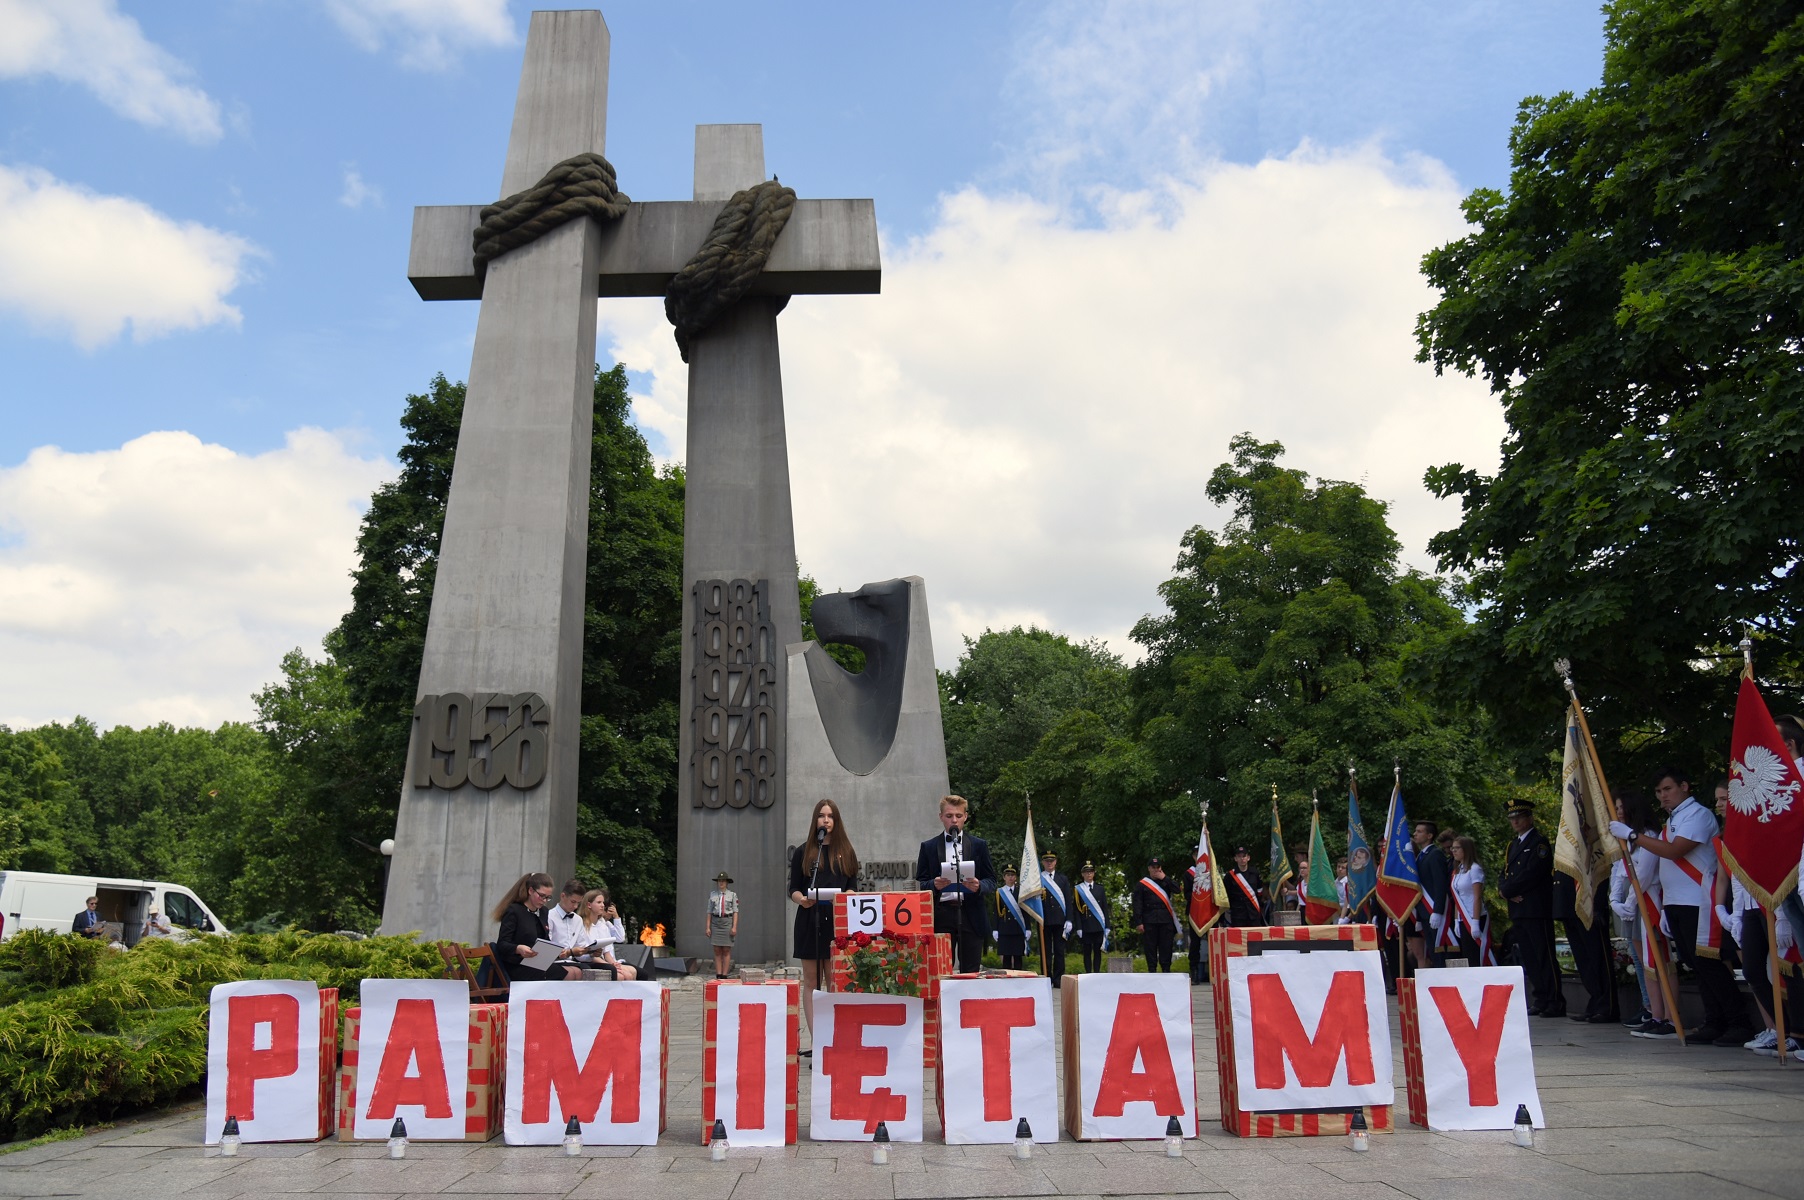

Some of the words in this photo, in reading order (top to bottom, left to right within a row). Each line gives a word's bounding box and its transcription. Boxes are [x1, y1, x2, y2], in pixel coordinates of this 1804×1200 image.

[693, 578, 771, 621] 1981
[692, 620, 777, 664] 1980
[692, 661, 776, 708] 1976
[414, 692, 549, 791] 1956
[691, 704, 776, 751] 1970
[691, 748, 776, 809] 1968
[866, 861, 909, 880] PRAWO
